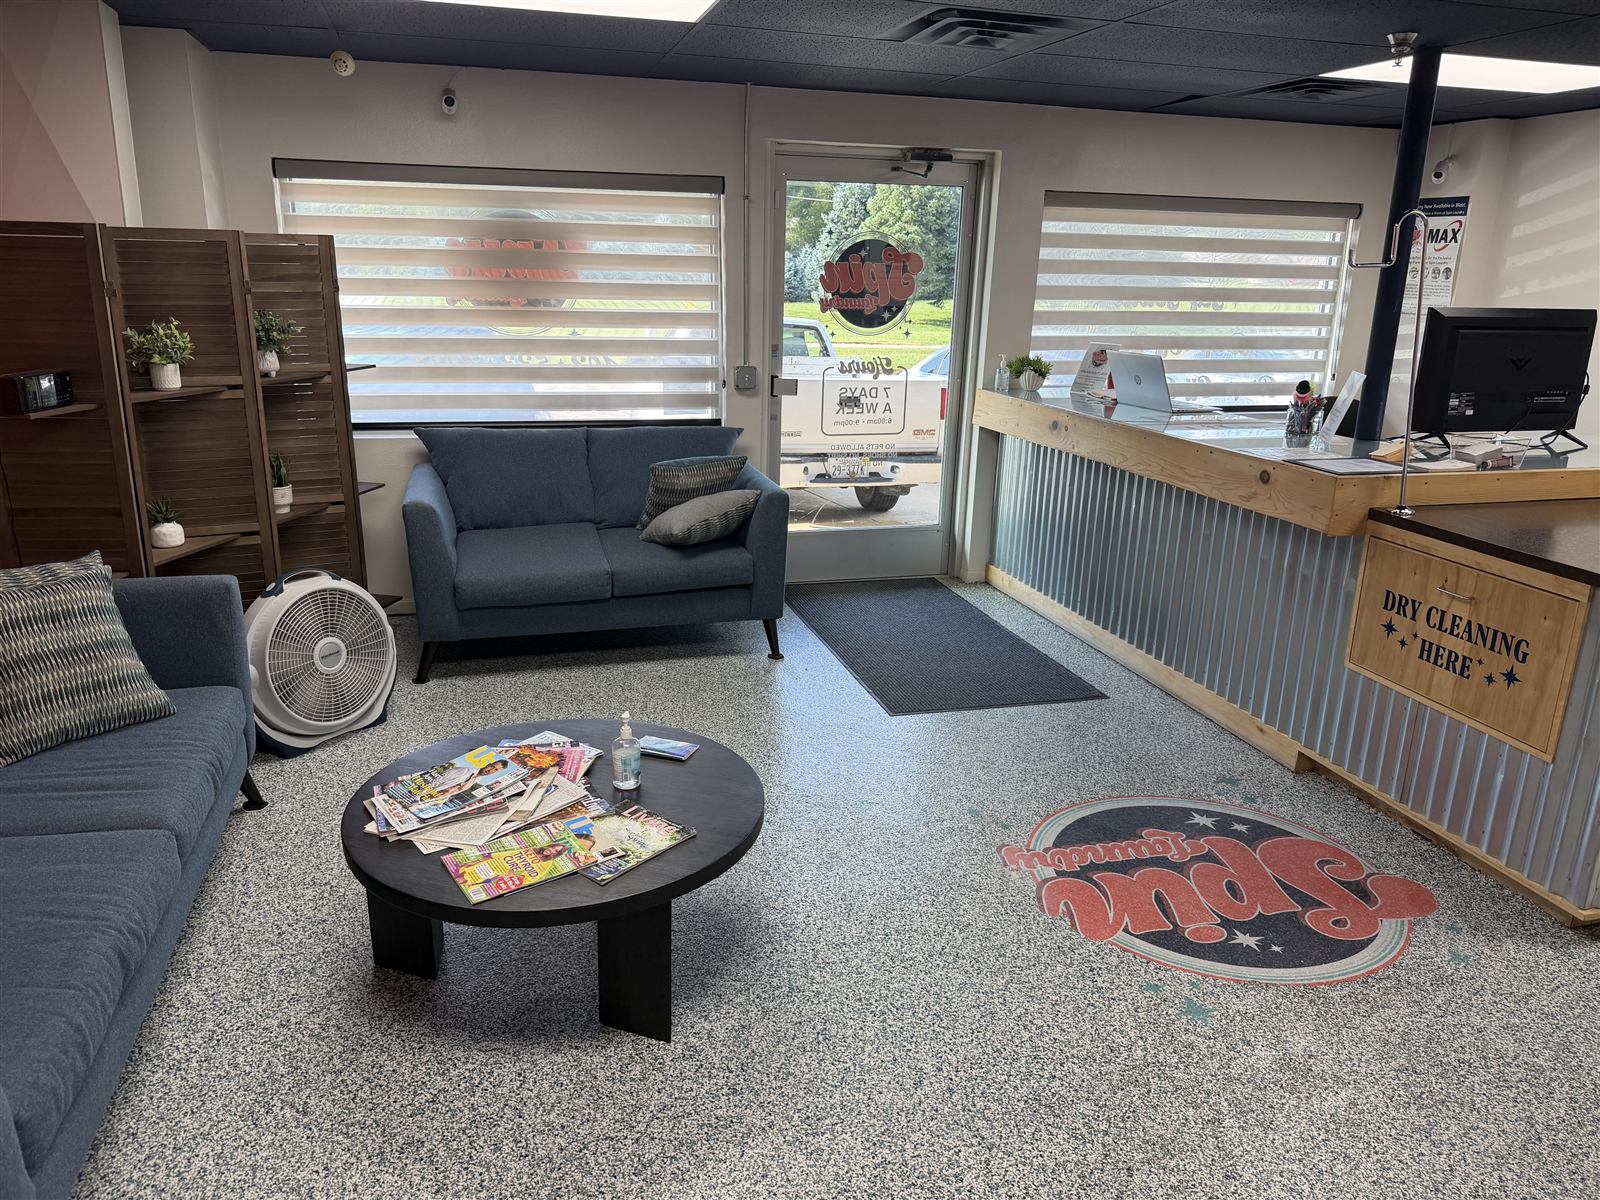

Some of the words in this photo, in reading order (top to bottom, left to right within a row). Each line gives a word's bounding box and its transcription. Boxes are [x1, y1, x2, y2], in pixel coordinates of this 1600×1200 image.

[1427, 228, 1461, 244] MAX
[1382, 589, 1423, 622] DRY
[1425, 605, 1530, 664] CLEANING
[1417, 638, 1474, 680] HERE
[621, 805, 680, 837] Living
[503, 855, 521, 872] CURE
[513, 852, 539, 878] THYROID
[522, 848, 541, 865] KETO
[997, 827, 1207, 872] Laundry
[1036, 834, 1437, 943] Spin
